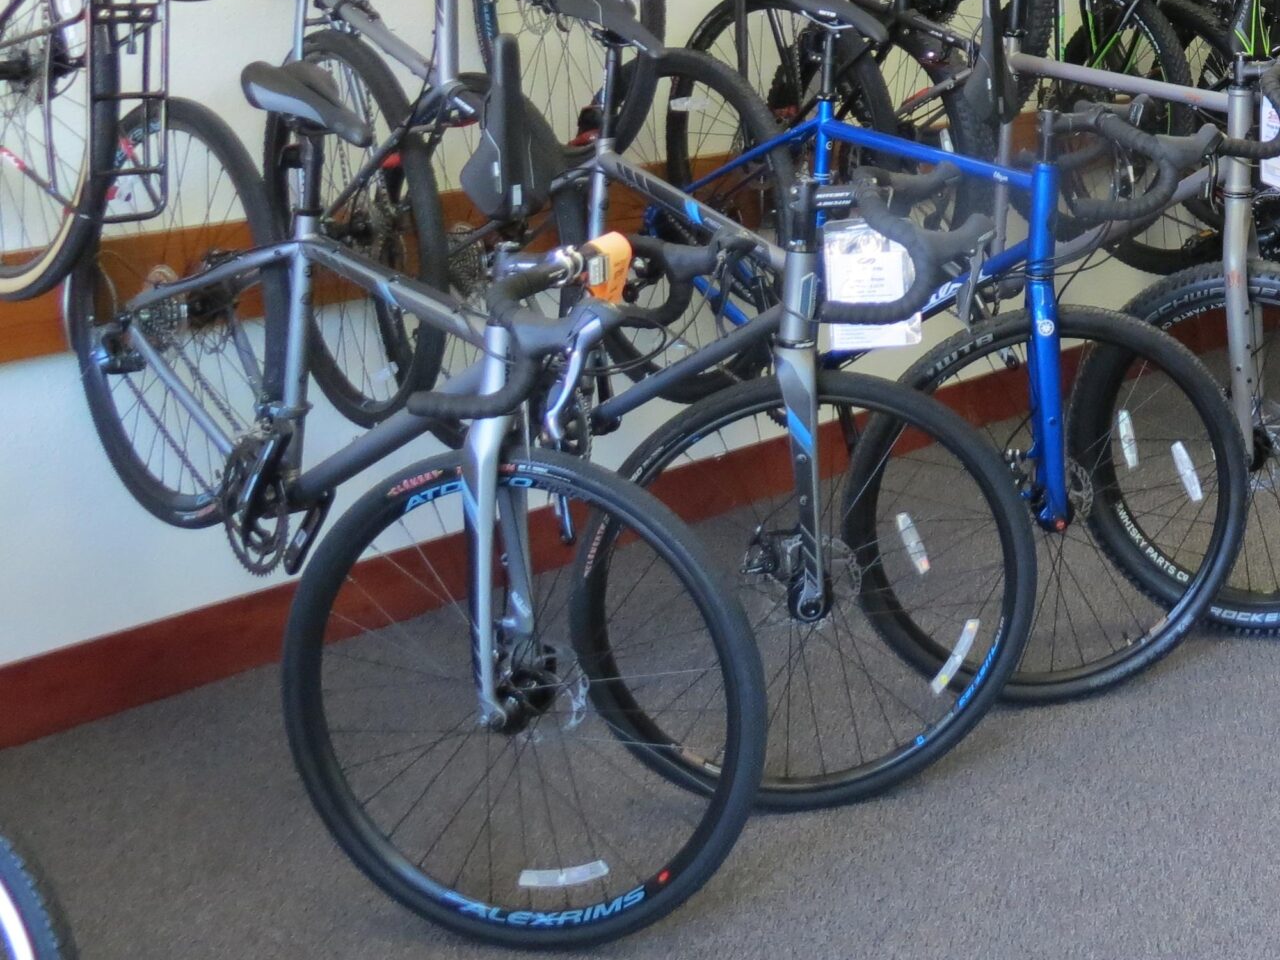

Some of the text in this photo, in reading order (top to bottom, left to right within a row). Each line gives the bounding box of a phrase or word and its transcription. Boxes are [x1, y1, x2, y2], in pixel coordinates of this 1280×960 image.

[934, 332, 995, 372] WTB
[1117, 507, 1148, 548] WHISKY
[1145, 545, 1177, 576] PARTS
